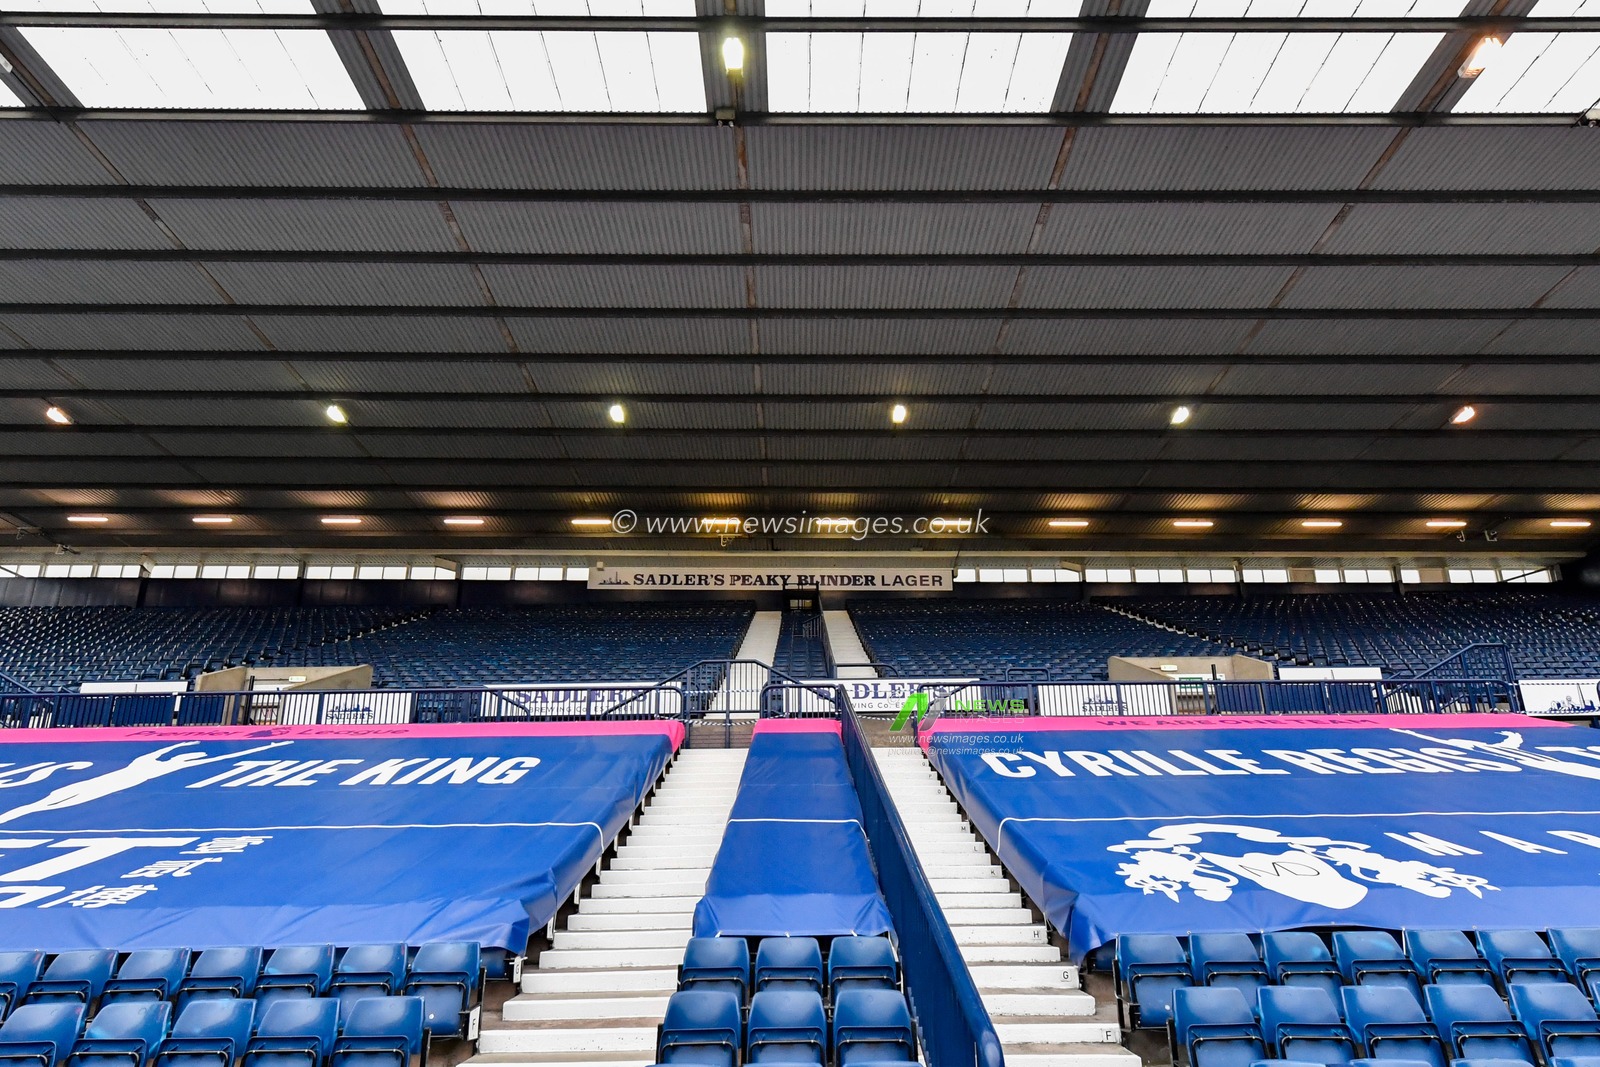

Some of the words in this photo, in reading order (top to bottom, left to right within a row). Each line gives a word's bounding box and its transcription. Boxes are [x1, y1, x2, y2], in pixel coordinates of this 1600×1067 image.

[633, 573, 725, 586] SADLER'S
[729, 574, 791, 586] PEAKY
[797, 574, 876, 587] BLINDER
[881, 574, 943, 587] LAGER
[514, 690, 647, 705] SADLERS
[1082, 704, 1128, 712] SADLERS
[126, 728, 243, 738] Premier
[297, 728, 410, 736] League
[980, 748, 1290, 778] CYRILLE
[1262, 746, 1523, 776] REGIS
[185, 760, 364, 789] THE
[338, 757, 541, 787] KING
[1062, 971, 1069, 979] G
[1106, 1030, 1112, 1040] F
